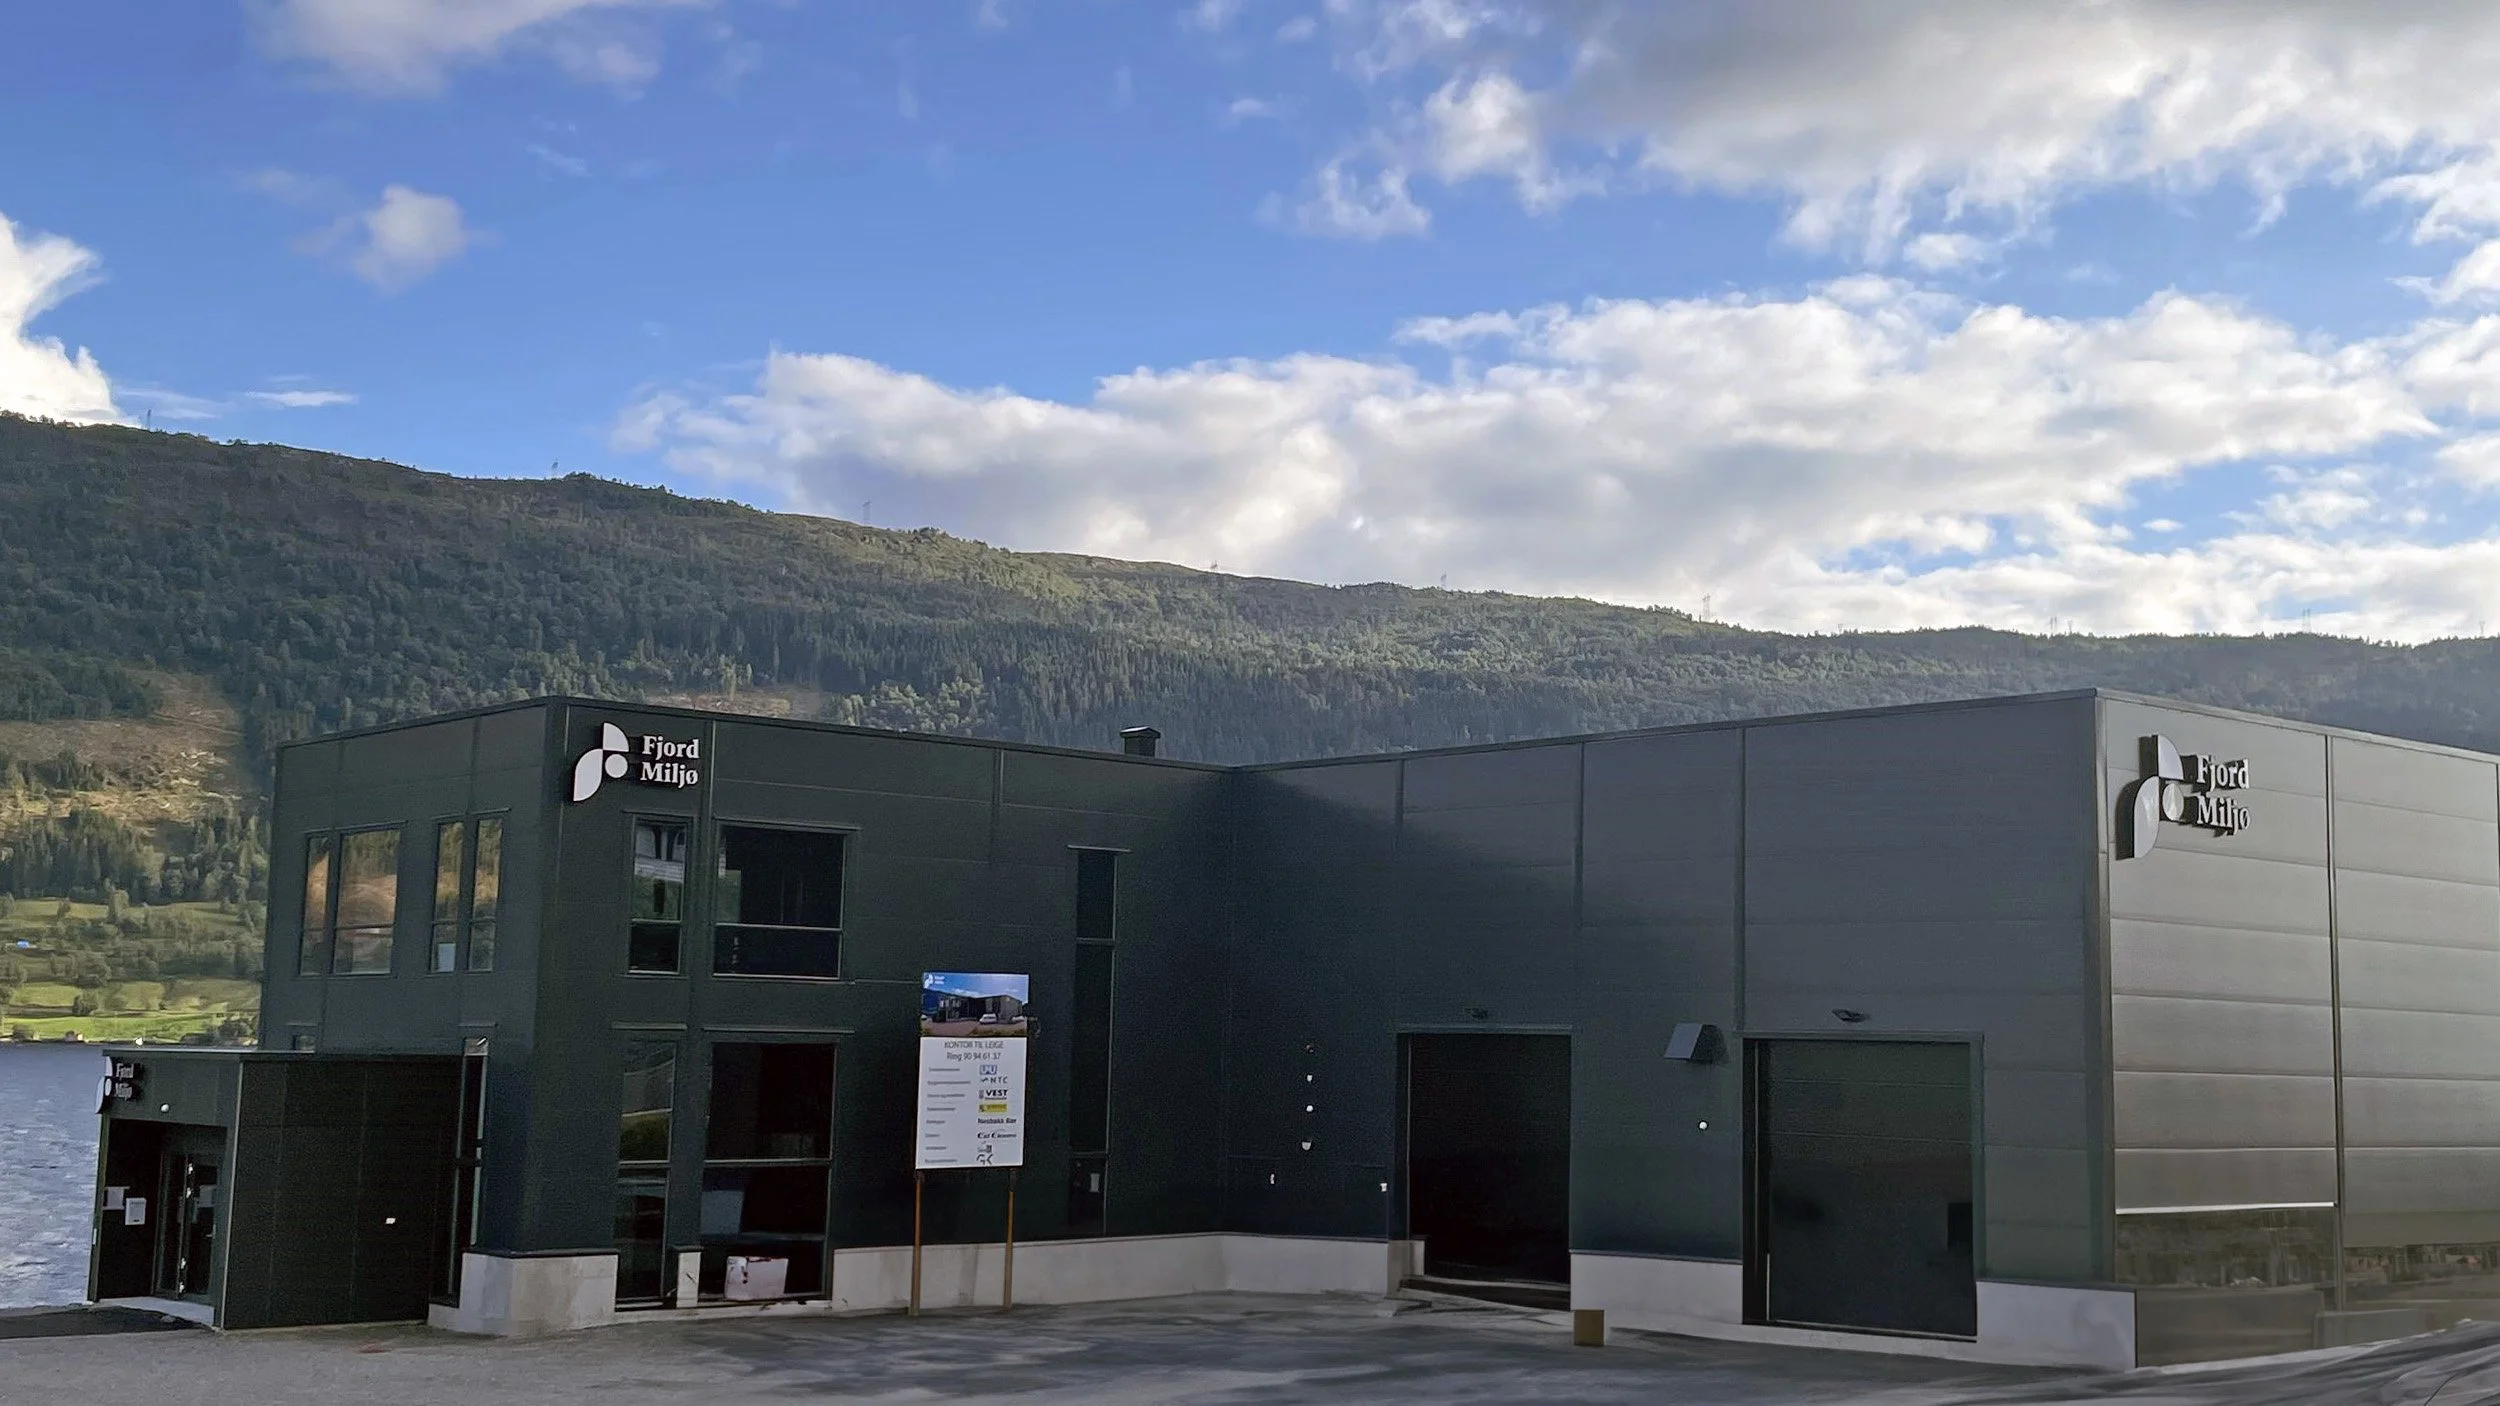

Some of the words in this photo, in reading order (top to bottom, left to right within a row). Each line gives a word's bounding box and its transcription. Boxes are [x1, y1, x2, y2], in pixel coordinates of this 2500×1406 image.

[641, 735, 700, 760] Fjord
[640, 762, 699, 789] Miljø
[2196, 755, 2249, 792] Fjord
[2196, 795, 2250, 835] Miljø
[946, 1052, 962, 1061] Ring
[974, 1041, 983, 1049] TIL
[984, 1041, 1004, 1049] LEIGE
[985, 1089, 1009, 1097] VEST
